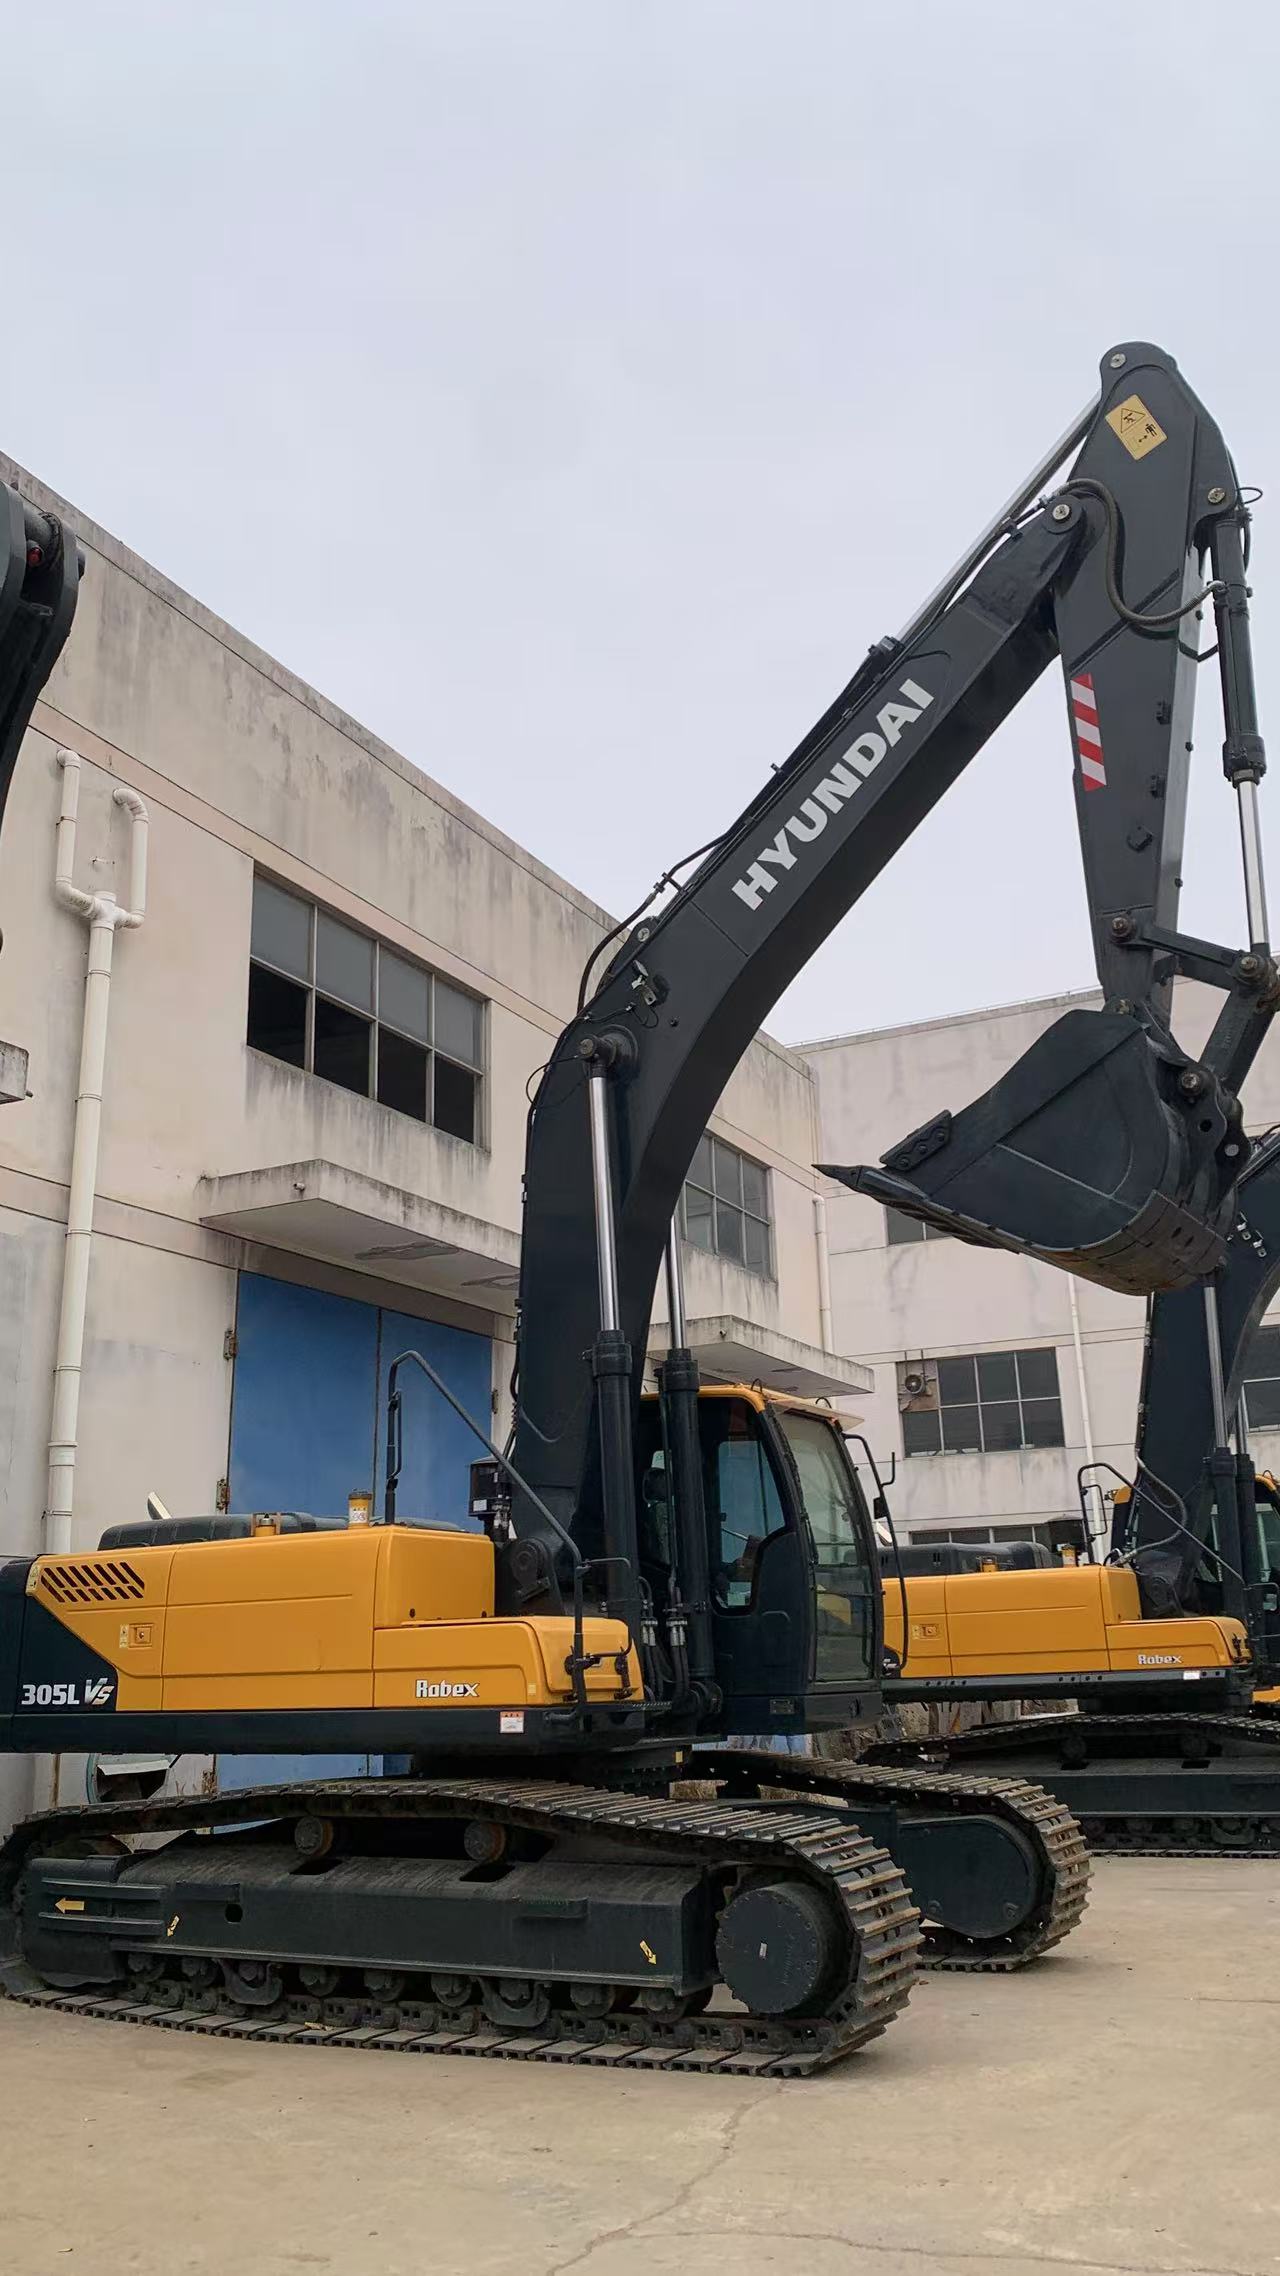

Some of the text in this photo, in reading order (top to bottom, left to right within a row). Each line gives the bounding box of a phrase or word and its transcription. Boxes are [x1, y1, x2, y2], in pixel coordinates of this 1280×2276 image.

[731, 679, 934, 910] HYUNDAI
[21, 1684, 80, 1705] 305L
[416, 1680, 479, 1698] Robex
